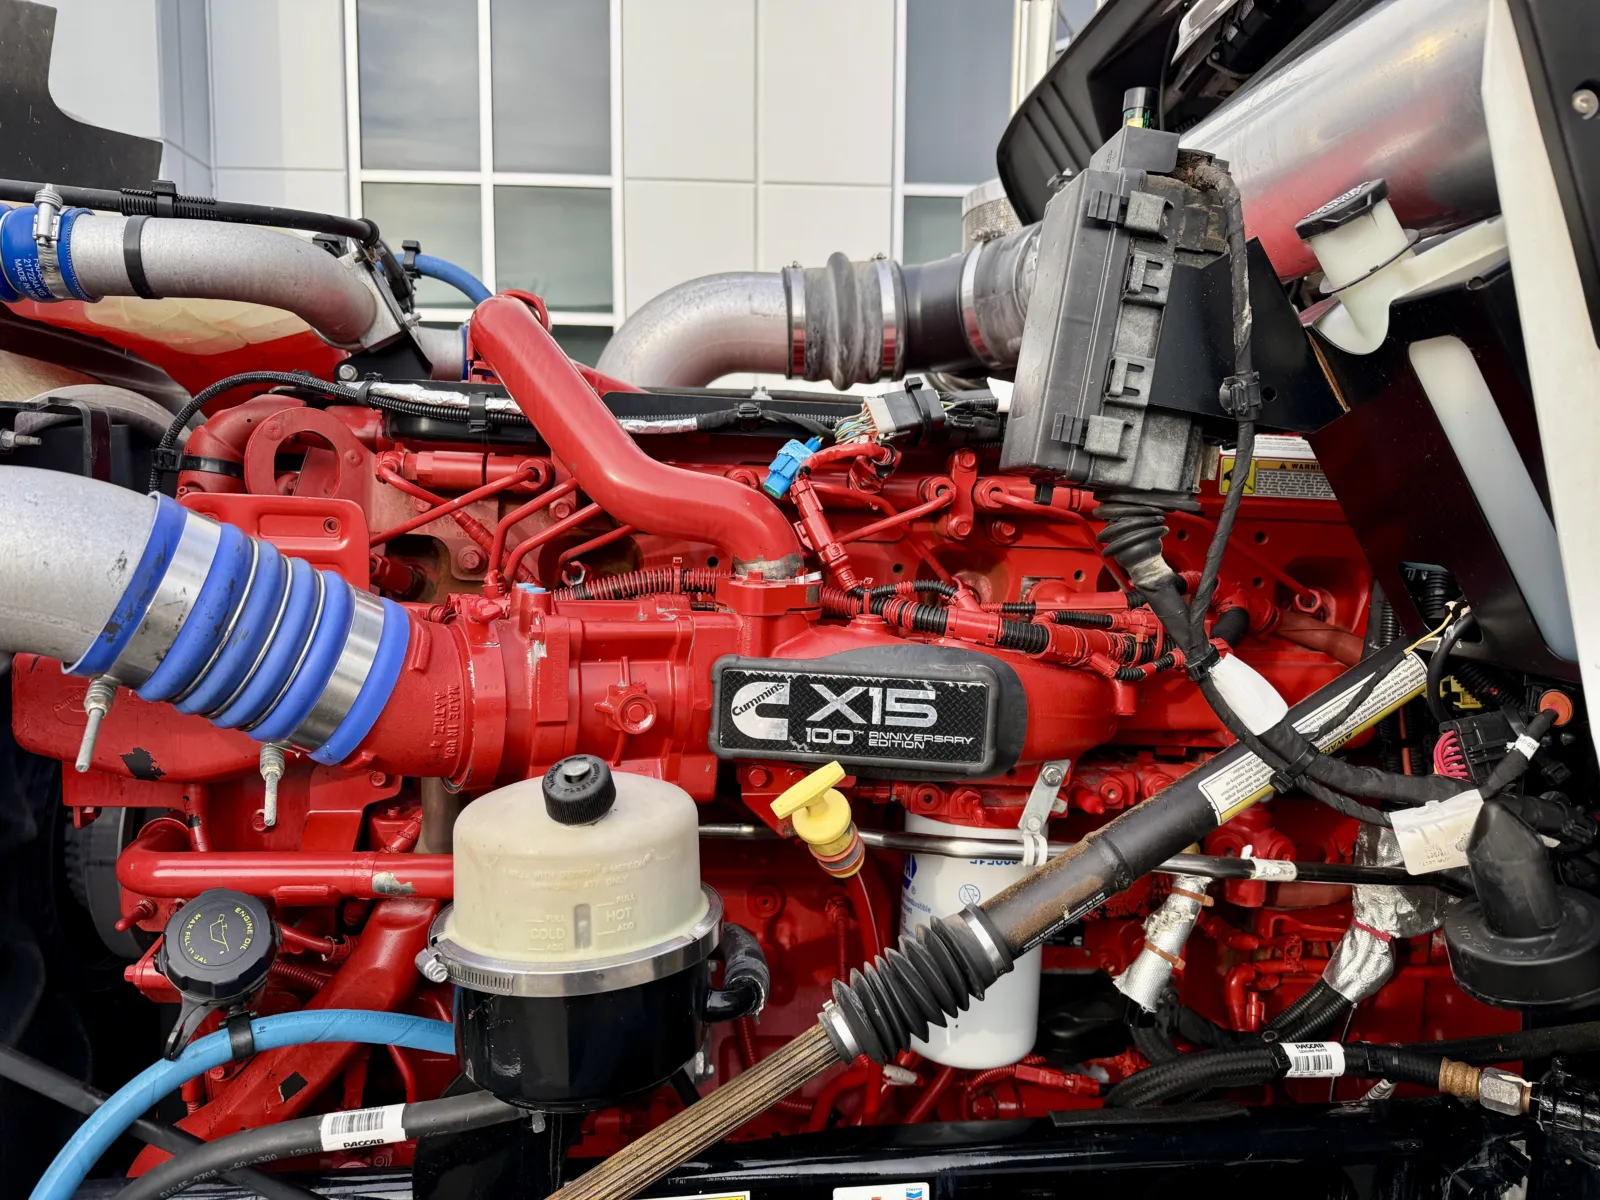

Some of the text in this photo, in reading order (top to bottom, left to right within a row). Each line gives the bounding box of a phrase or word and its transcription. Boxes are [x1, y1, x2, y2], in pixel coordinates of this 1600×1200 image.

[14, 259, 27, 282] MADE
[732, 682, 938, 727] Cummins X15
[868, 732, 975, 745] ANNIVERSARY
[868, 738, 925, 749] EDITION
[606, 875, 628, 886] ONLY
[616, 894, 636, 904] FULL
[606, 907, 632, 922] HOT
[187, 914, 202, 930] MAX
[234, 907, 254, 950] ENGINE OIL
[617, 922, 634, 932] ADD
[530, 928, 566, 940] COLD
